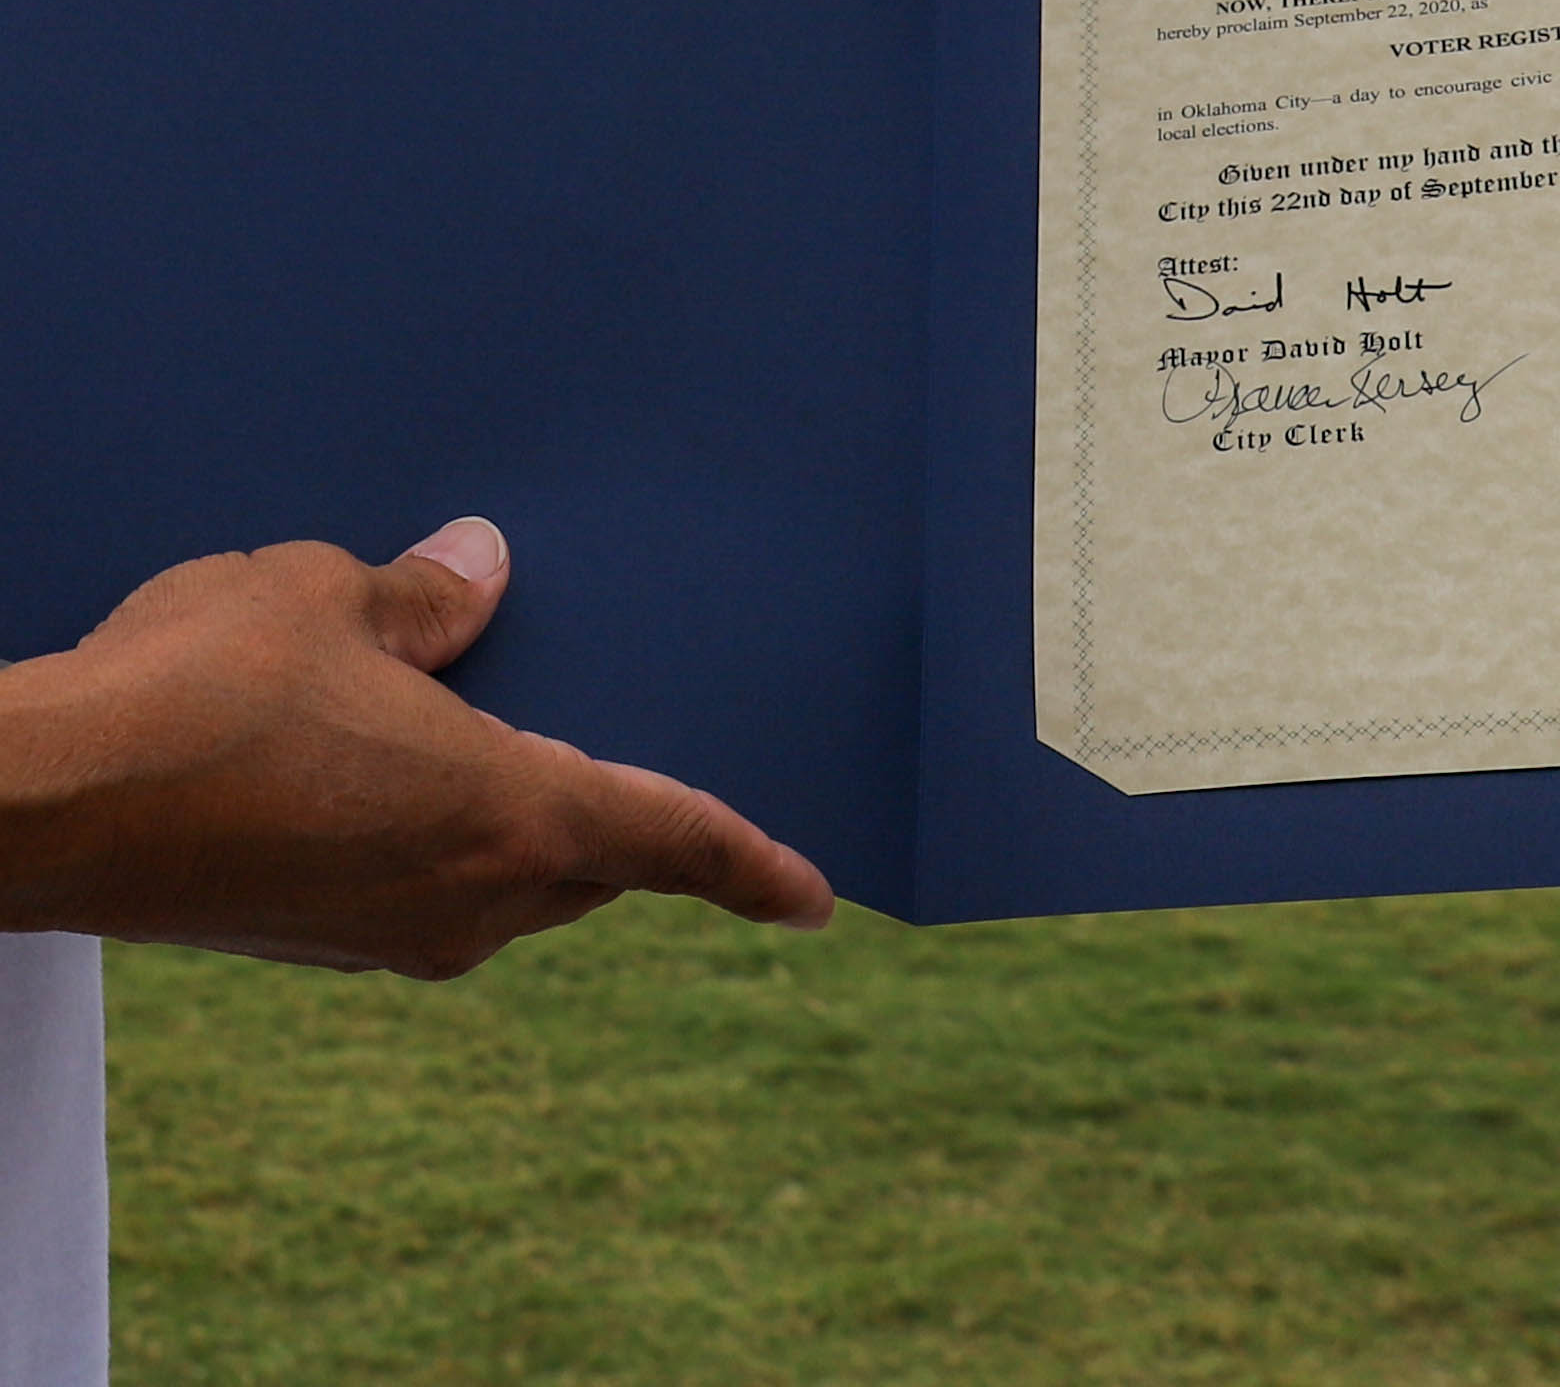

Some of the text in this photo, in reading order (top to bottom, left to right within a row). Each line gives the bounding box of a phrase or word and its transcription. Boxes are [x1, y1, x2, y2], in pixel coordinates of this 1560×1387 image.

[1157, 24, 1211, 41] hereby
[1216, 18, 1289, 39] proclaim
[1293, 7, 1384, 29] September
[1387, 3, 1414, 19] 22,
[1470, 0, 1489, 11] as
[1389, 36, 1473, 58] VOTER
[1157, 107, 1173, 122] in
[1180, 101, 1267, 119] Oklahoma
[1275, 94, 1342, 111] City—a
[1349, 88, 1380, 105] day
[1388, 87, 1406, 100] to
[1414, 78, 1502, 98] encourage
[1510, 73, 1552, 88] civic
[1157, 120, 1279, 142] local elections.
[1218, 163, 1291, 186] Given
[1299, 155, 1369, 177] under
[1377, 153, 1414, 173] my
[1422, 143, 1481, 170] hand
[1489, 138, 1534, 160] and
[1158, 201, 1210, 224] City
[1217, 195, 1262, 220] this
[1270, 188, 1331, 213] 22nd
[1338, 186, 1382, 208] day
[1390, 180, 1413, 202] of
[1420, 170, 1559, 200] September
[1157, 254, 1239, 279] Attest:
[1346, 276, 1453, 312] Holt
[1157, 330, 1424, 371] Mayor David Holt
[1212, 422, 1366, 453] City Clerk
